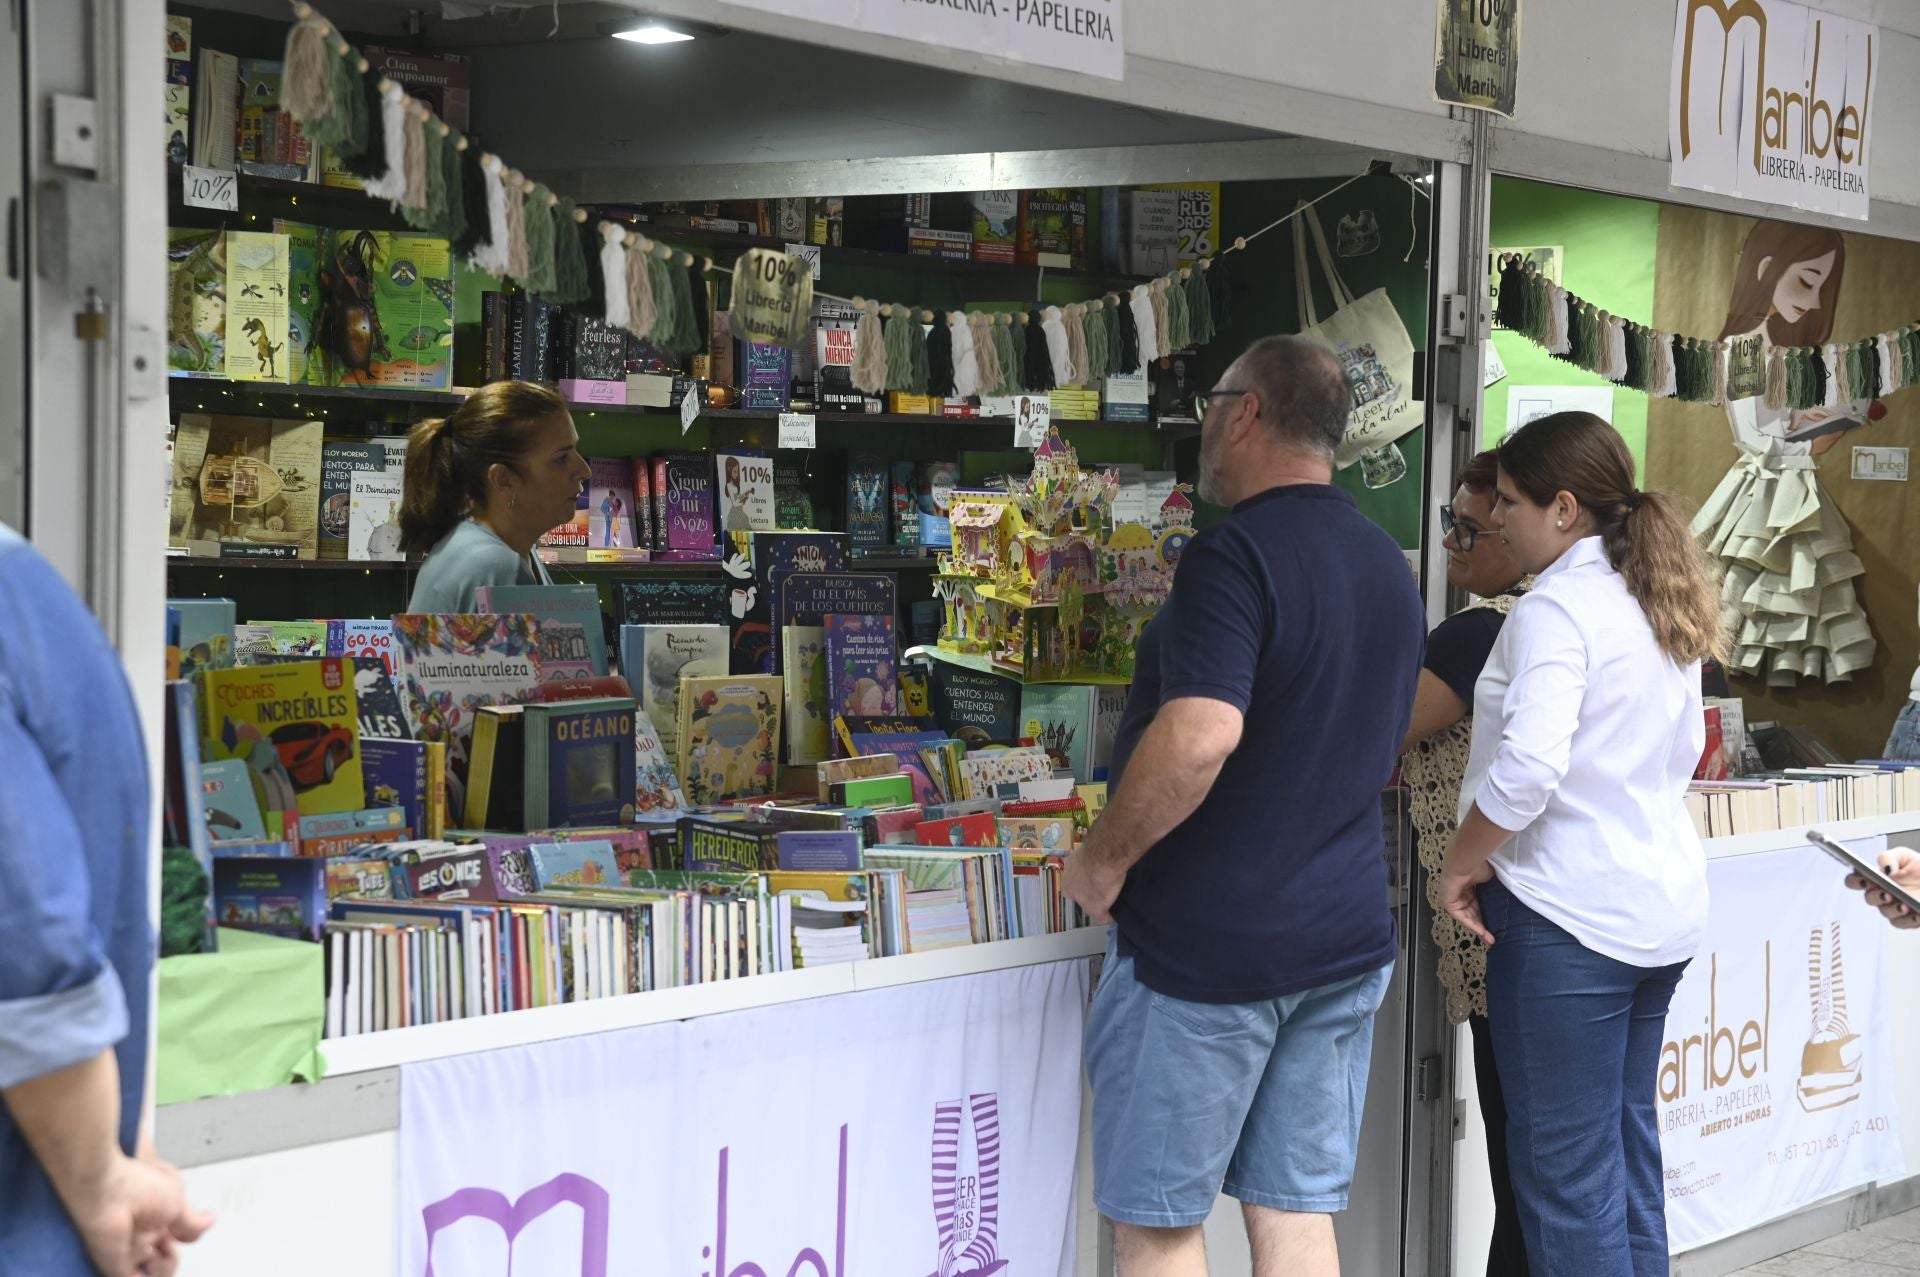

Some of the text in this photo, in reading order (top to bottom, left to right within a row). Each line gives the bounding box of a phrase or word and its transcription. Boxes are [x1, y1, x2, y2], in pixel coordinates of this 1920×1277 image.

[1016, 0, 1114, 42] PAPELERIA
[386, 57, 418, 72] Clara
[1457, 74, 1507, 98] Maribel
[1680, 0, 1872, 175] Maribel
[1761, 154, 1806, 183] LIBRERIA
[1814, 167, 1865, 194] PAPELERIA
[189, 176, 233, 203] 10%
[1143, 206, 1172, 215] CUANDO
[1178, 201, 1213, 217] RLD
[1139, 223, 1175, 232] DIVERTIDO
[1177, 216, 1212, 229] ORDS
[1177, 228, 1212, 260] 26
[753, 254, 797, 287] 10%
[582, 323, 621, 344] Fearless
[743, 316, 789, 339] Maribel
[826, 330, 852, 347] NUNCA
[824, 346, 856, 365] MIENTAS
[1736, 338, 1758, 358] 10%
[1031, 402, 1049, 415] 10%
[341, 450, 369, 458] MORENO
[321, 460, 375, 471] UENTOS PARA
[325, 472, 352, 480] ENTEN
[741, 466, 771, 485] 10%
[323, 482, 333, 490] EL
[355, 484, 401, 496] El Principito
[668, 467, 707, 505] Sigue
[681, 494, 700, 513] mi
[750, 497, 767, 505] Libros
[565, 524, 578, 533] UNA
[750, 517, 769, 525] Lectura
[547, 534, 586, 546] OSIBILIDAD
[812, 587, 868, 600] EN EL PAÍS
[795, 601, 884, 613] DE LOS CUENTOS
[347, 633, 391, 648] GO, GO,
[846, 634, 867, 643] Cuentos
[867, 633, 874, 643] de
[842, 648, 855, 656] para
[855, 646, 866, 655] leer
[874, 648, 889, 657] prisa
[418, 661, 529, 679] iluminaturaleza
[952, 675, 999, 686] ELOY MORENO
[944, 686, 1005, 701] CUENTOS PARA
[256, 691, 348, 724] INCREÍBLES
[953, 700, 994, 713] ENTENDER
[950, 711, 996, 724] EL MUNDO
[557, 712, 630, 742] OCÉANO
[692, 831, 759, 871] HEREDEROS
[418, 871, 439, 891] LOS
[438, 858, 482, 886] ONCE
[1658, 939, 1770, 1103] aribel
[1715, 1083, 1772, 1116] PAPELERIA
[1700, 1105, 1772, 1139] ABIERTO 24 HORAS
